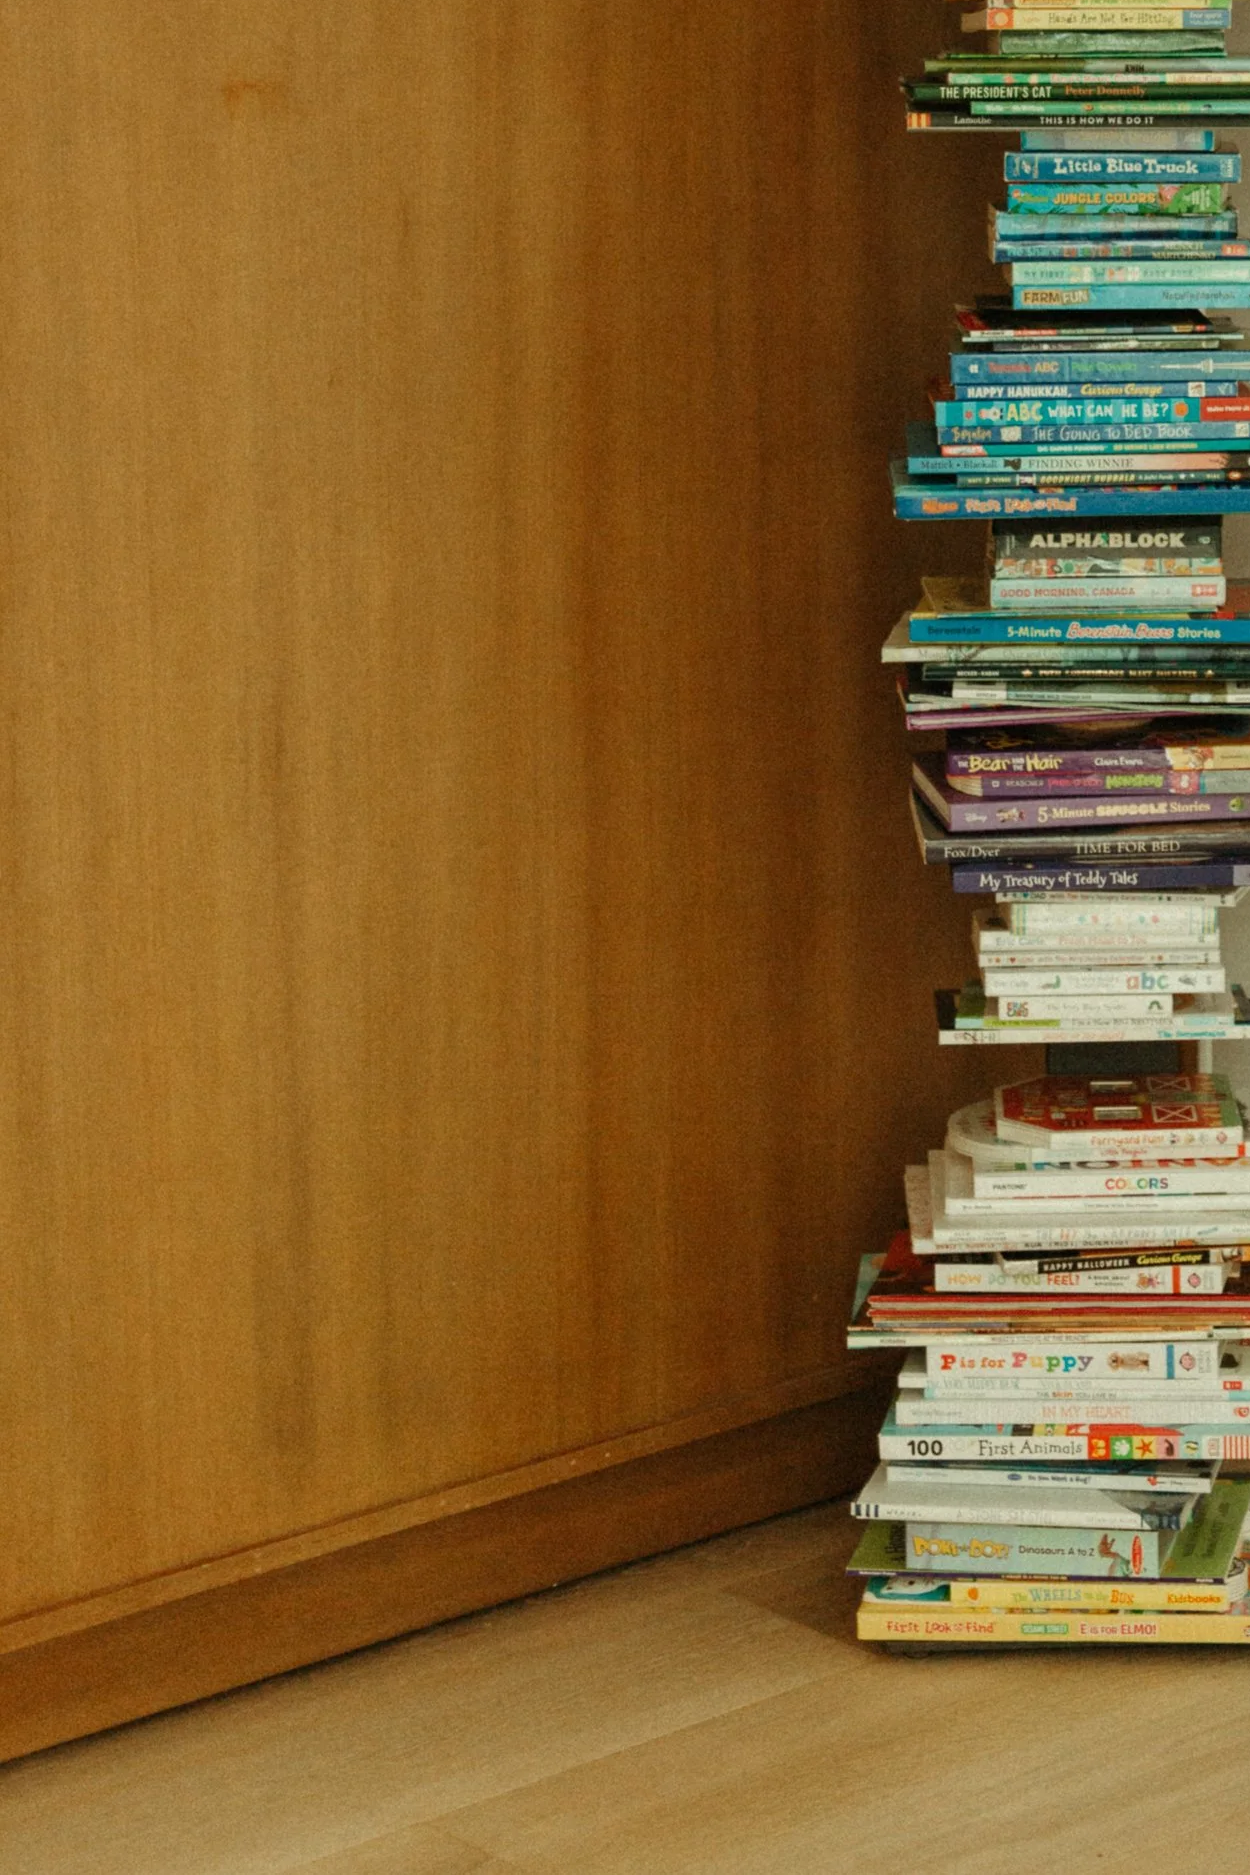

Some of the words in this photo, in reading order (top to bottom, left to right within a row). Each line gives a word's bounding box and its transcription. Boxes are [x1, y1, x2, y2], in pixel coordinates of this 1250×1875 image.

[1049, 13, 1077, 26] Hands
[1081, 13, 1097, 24] Are
[1100, 13, 1115, 24] Not
[1137, 13, 1176, 26] Hitting
[940, 86, 959, 98] THE
[962, 86, 1029, 98] PRESIDENT'S
[1032, 86, 1052, 98] CAT
[1065, 86, 1094, 95] Peter
[1096, 86, 1145, 96] Donnelly
[954, 116, 992, 124] Lamothe
[1054, 157, 1101, 174] Little
[1107, 157, 1142, 173] Blue
[1144, 158, 1199, 174] Truck
[1054, 192, 1102, 204] JUNGLE
[1106, 192, 1155, 203] COLORS
[1023, 292, 1059, 303] FARM
[1063, 291, 1088, 303] FUN
[988, 363, 1031, 373] Toronto
[1035, 362, 1059, 373] ABC
[967, 387, 1003, 398] HAPPY
[1008, 386, 1072, 398] HANUKKAH,
[1080, 384, 1123, 395] Curious
[1124, 383, 1163, 396] George
[1007, 402, 1043, 422] ABC
[1048, 405, 1083, 417] WHAT
[1086, 405, 1113, 417] CAN
[1122, 405, 1137, 417] HE
[1143, 402, 1169, 417] BE?
[952, 427, 992, 441] Boynton
[1032, 427, 1056, 441] THE
[1060, 427, 1100, 441] GOING
[1123, 426, 1152, 438] BED
[1158, 426, 1193, 438] BOOK
[1028, 460, 1083, 469] FINDING
[1040, 475, 1091, 483] GOODNIGHT
[1030, 533, 1186, 548] ALPHABLOCK
[999, 589, 1031, 597] GOOD
[1034, 588, 1089, 597] MORNING,
[1092, 588, 1136, 596] CANADA
[927, 627, 981, 635] Berenstain
[1007, 627, 1062, 638] 5-Minute
[1177, 628, 1221, 639] Stories
[968, 755, 1010, 773] Bear
[1025, 753, 1063, 772] Hair
[964, 813, 987, 822] Disney
[1096, 805, 1168, 813] SNUGGLE
[1170, 801, 1211, 812] Stories
[944, 846, 1000, 858] Fox/Dyer
[1076, 843, 1111, 854] TIME
[1118, 841, 1147, 853] FOR
[1152, 840, 1180, 852] BED
[980, 874, 1000, 890] My
[1003, 873, 1054, 890] Treasury
[1058, 872, 1071, 887] of
[1074, 871, 1107, 888] Teddy
[1110, 872, 1138, 885] Tales
[1126, 972, 1169, 989] abc
[1105, 1178, 1168, 1190] COLORS
[1043, 1263, 1073, 1271] HAPPY
[1137, 1254, 1171, 1265] Curious
[1172, 1253, 1203, 1263] George
[948, 1275, 981, 1285] HOW
[989, 1275, 1008, 1285] DO
[1013, 1275, 1041, 1285] YOU
[1047, 1273, 1080, 1285] FEEL?
[940, 1354, 956, 1370] P
[960, 1355, 975, 1368] is
[981, 1354, 1006, 1368] for
[1012, 1352, 1093, 1372] Puppy
[1042, 1407, 1057, 1418] IN
[1061, 1407, 1081, 1417] MY
[1087, 1406, 1132, 1418] HEART
[907, 1440, 943, 1455] 100
[978, 1439, 1014, 1456] First
[1019, 1439, 1083, 1455] Animals
[1018, 1545, 1066, 1555] Dinosaurs
[1077, 1548, 1087, 1556] to
[1088, 1548, 1095, 1556] Z
[1029, 1589, 1082, 1601] WHEELS
[1166, 1593, 1221, 1605] Kidsbooks
[886, 1621, 919, 1633] First
[925, 1621, 952, 1634] Look
[966, 1622, 994, 1634] Find
[1080, 1625, 1087, 1634] E
[1121, 1623, 1157, 1635] ELMO!
